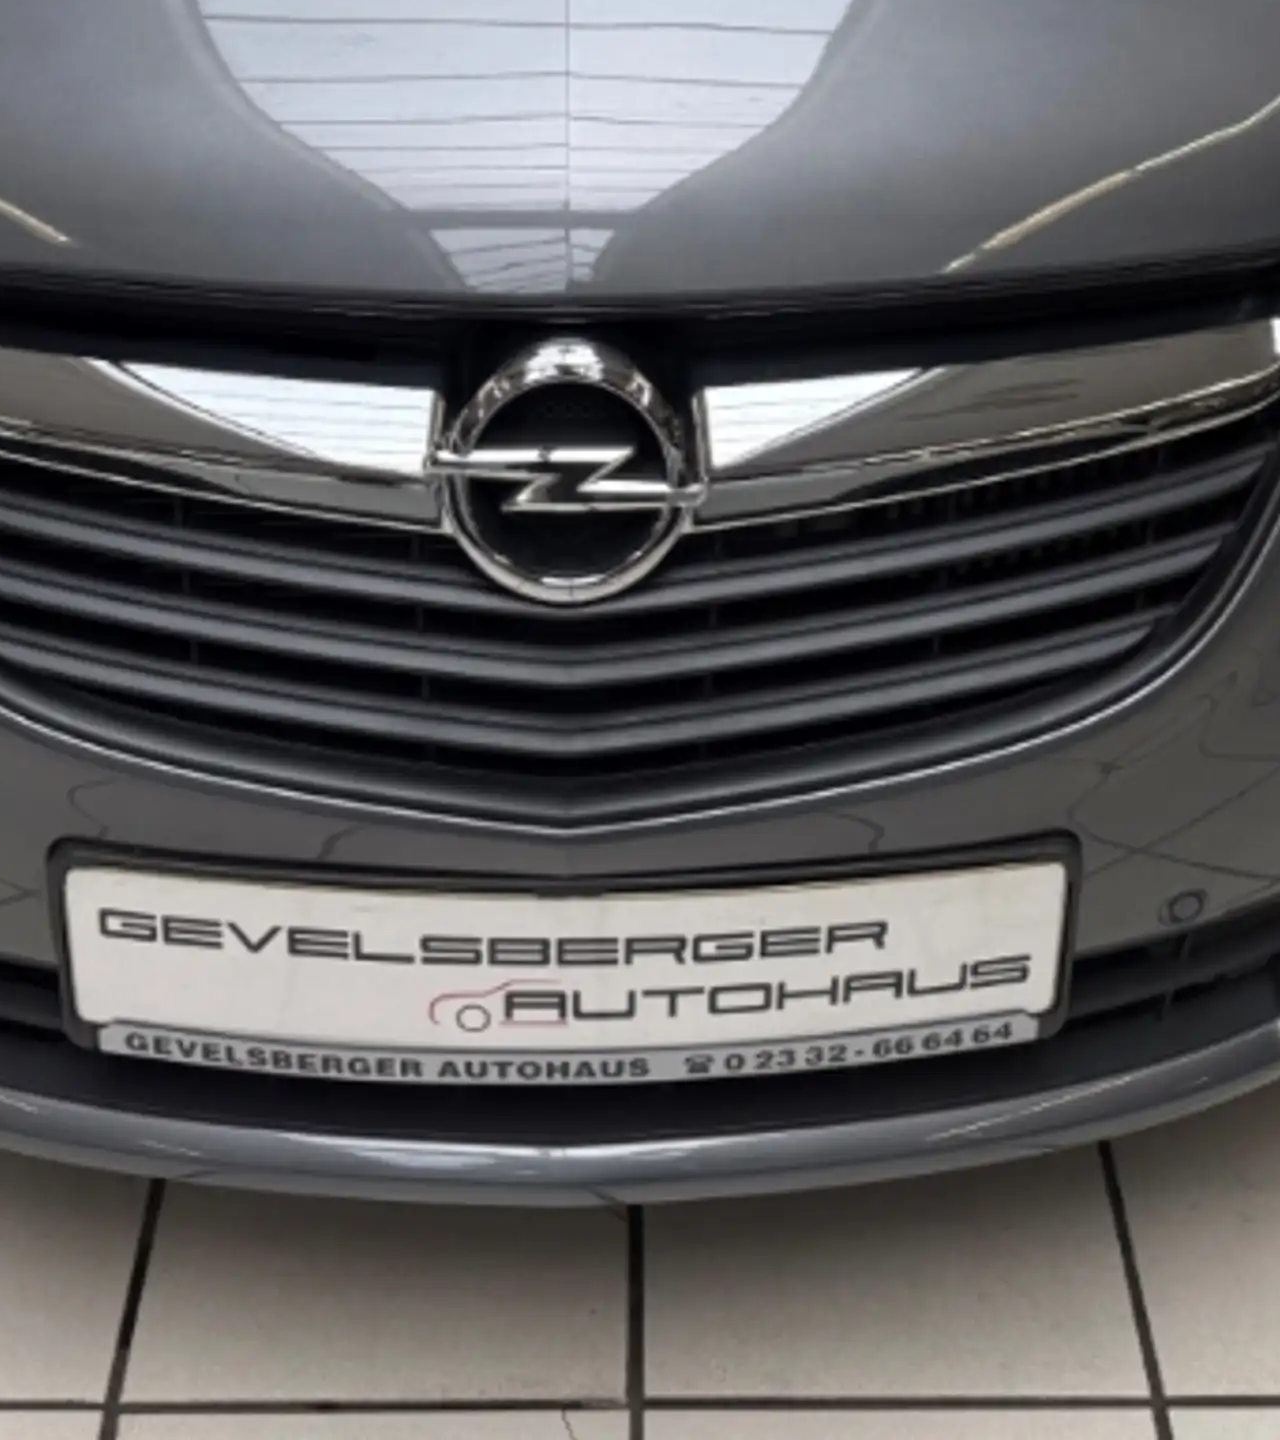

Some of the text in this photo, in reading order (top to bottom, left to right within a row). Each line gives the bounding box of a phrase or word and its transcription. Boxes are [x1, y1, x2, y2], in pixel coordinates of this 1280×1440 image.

[98, 907, 888, 967] GEVELSBERGER
[504, 954, 1031, 1021] AUTOHAUS
[124, 1032, 424, 1078] GEVELSBERGER
[437, 1058, 651, 1080] AUTOHAUS
